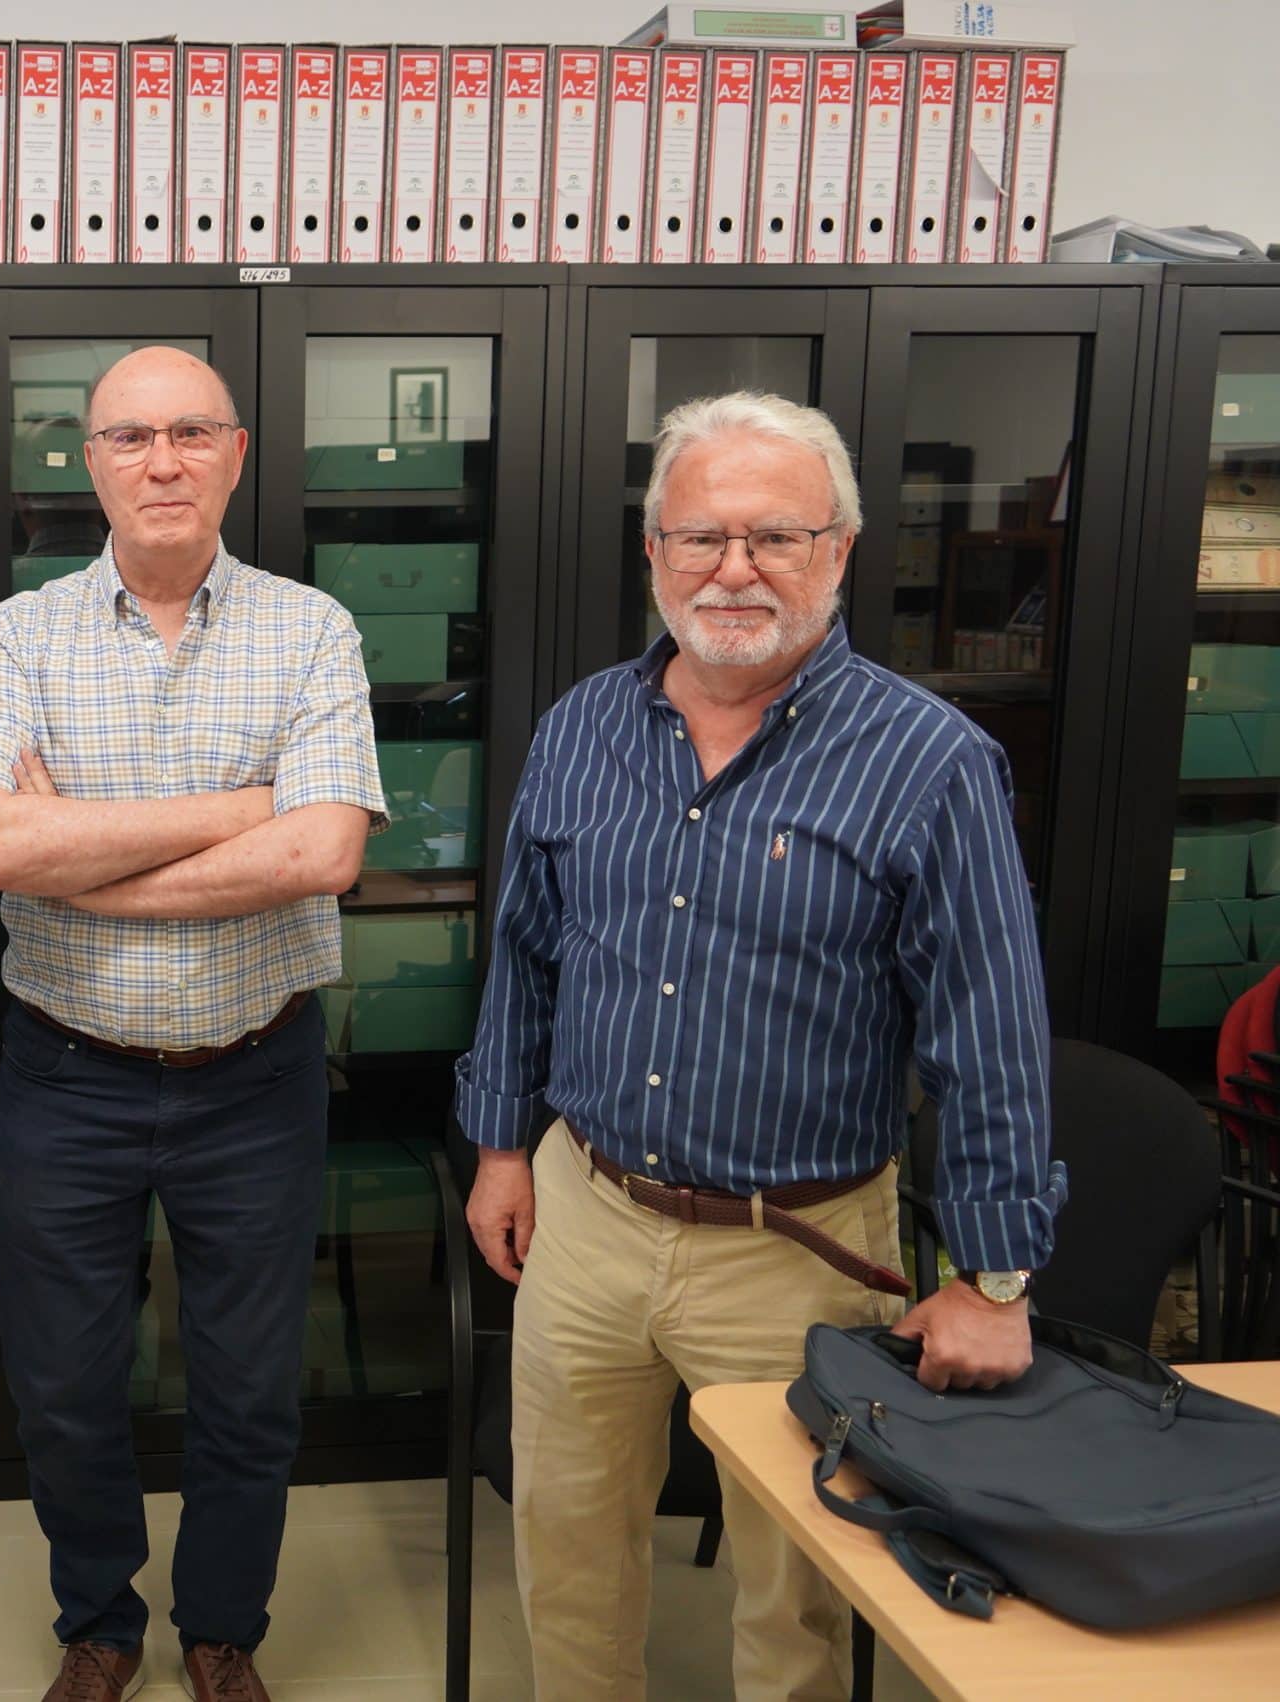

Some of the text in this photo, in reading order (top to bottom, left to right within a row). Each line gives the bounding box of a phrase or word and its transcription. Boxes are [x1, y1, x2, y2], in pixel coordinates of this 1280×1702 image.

[24, 77, 58, 95] A-Z
[80, 78, 114, 96] A-Z
[136, 78, 169, 96] A-Z
[191, 78, 224, 96] A-Z
[244, 79, 278, 97] A-Z
[298, 79, 330, 97] A-Z
[349, 81, 383, 97] A-Z
[402, 81, 436, 97] A-Z
[455, 80, 488, 97] A-Z
[507, 79, 540, 96] A-Z
[562, 80, 595, 96] A-Z
[615, 81, 647, 97] A-Z
[665, 82, 697, 99] A-Z
[718, 82, 750, 99] A-Z
[770, 84, 802, 100] A-Z
[819, 84, 851, 101] A-Z
[870, 84, 902, 101] A-Z
[922, 84, 953, 101] A-Z
[975, 84, 1006, 101] A-Z
[1024, 84, 1055, 101] A-Z
